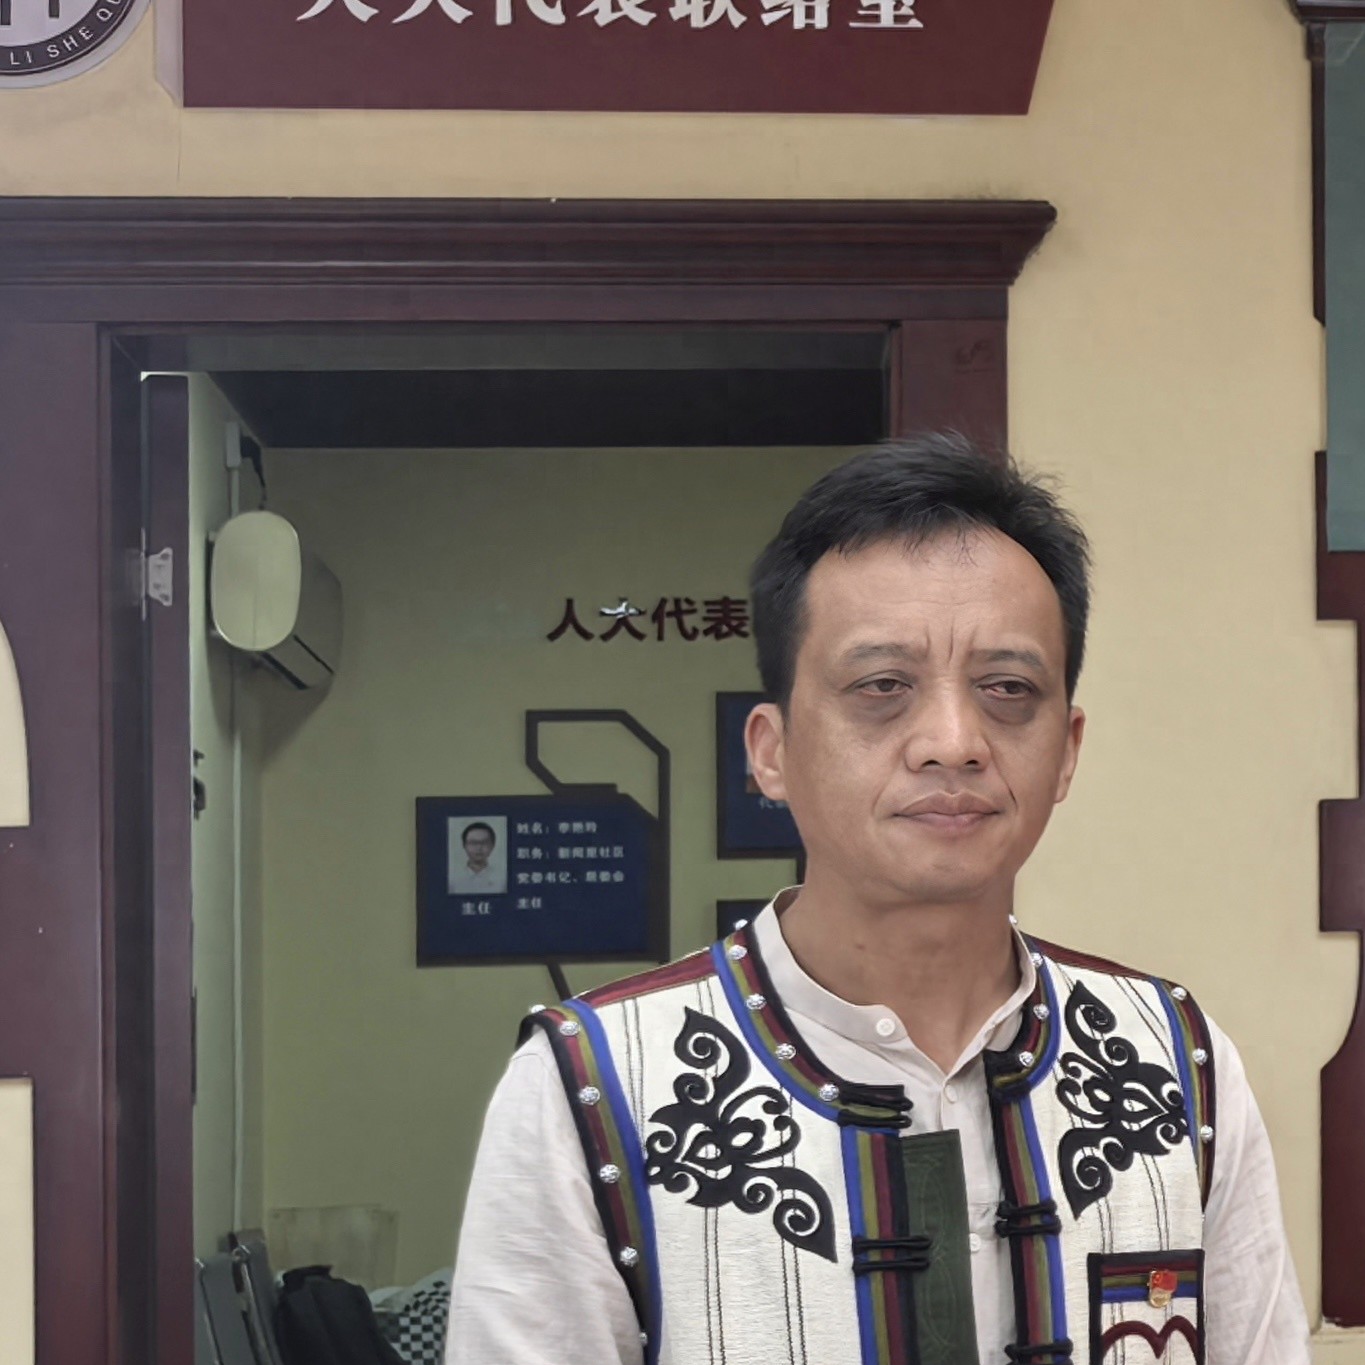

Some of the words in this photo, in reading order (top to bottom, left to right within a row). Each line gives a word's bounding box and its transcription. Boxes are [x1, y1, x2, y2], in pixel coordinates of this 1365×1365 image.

[47, 26, 95, 58] SHE
[546, 596, 750, 642] 人大代表
